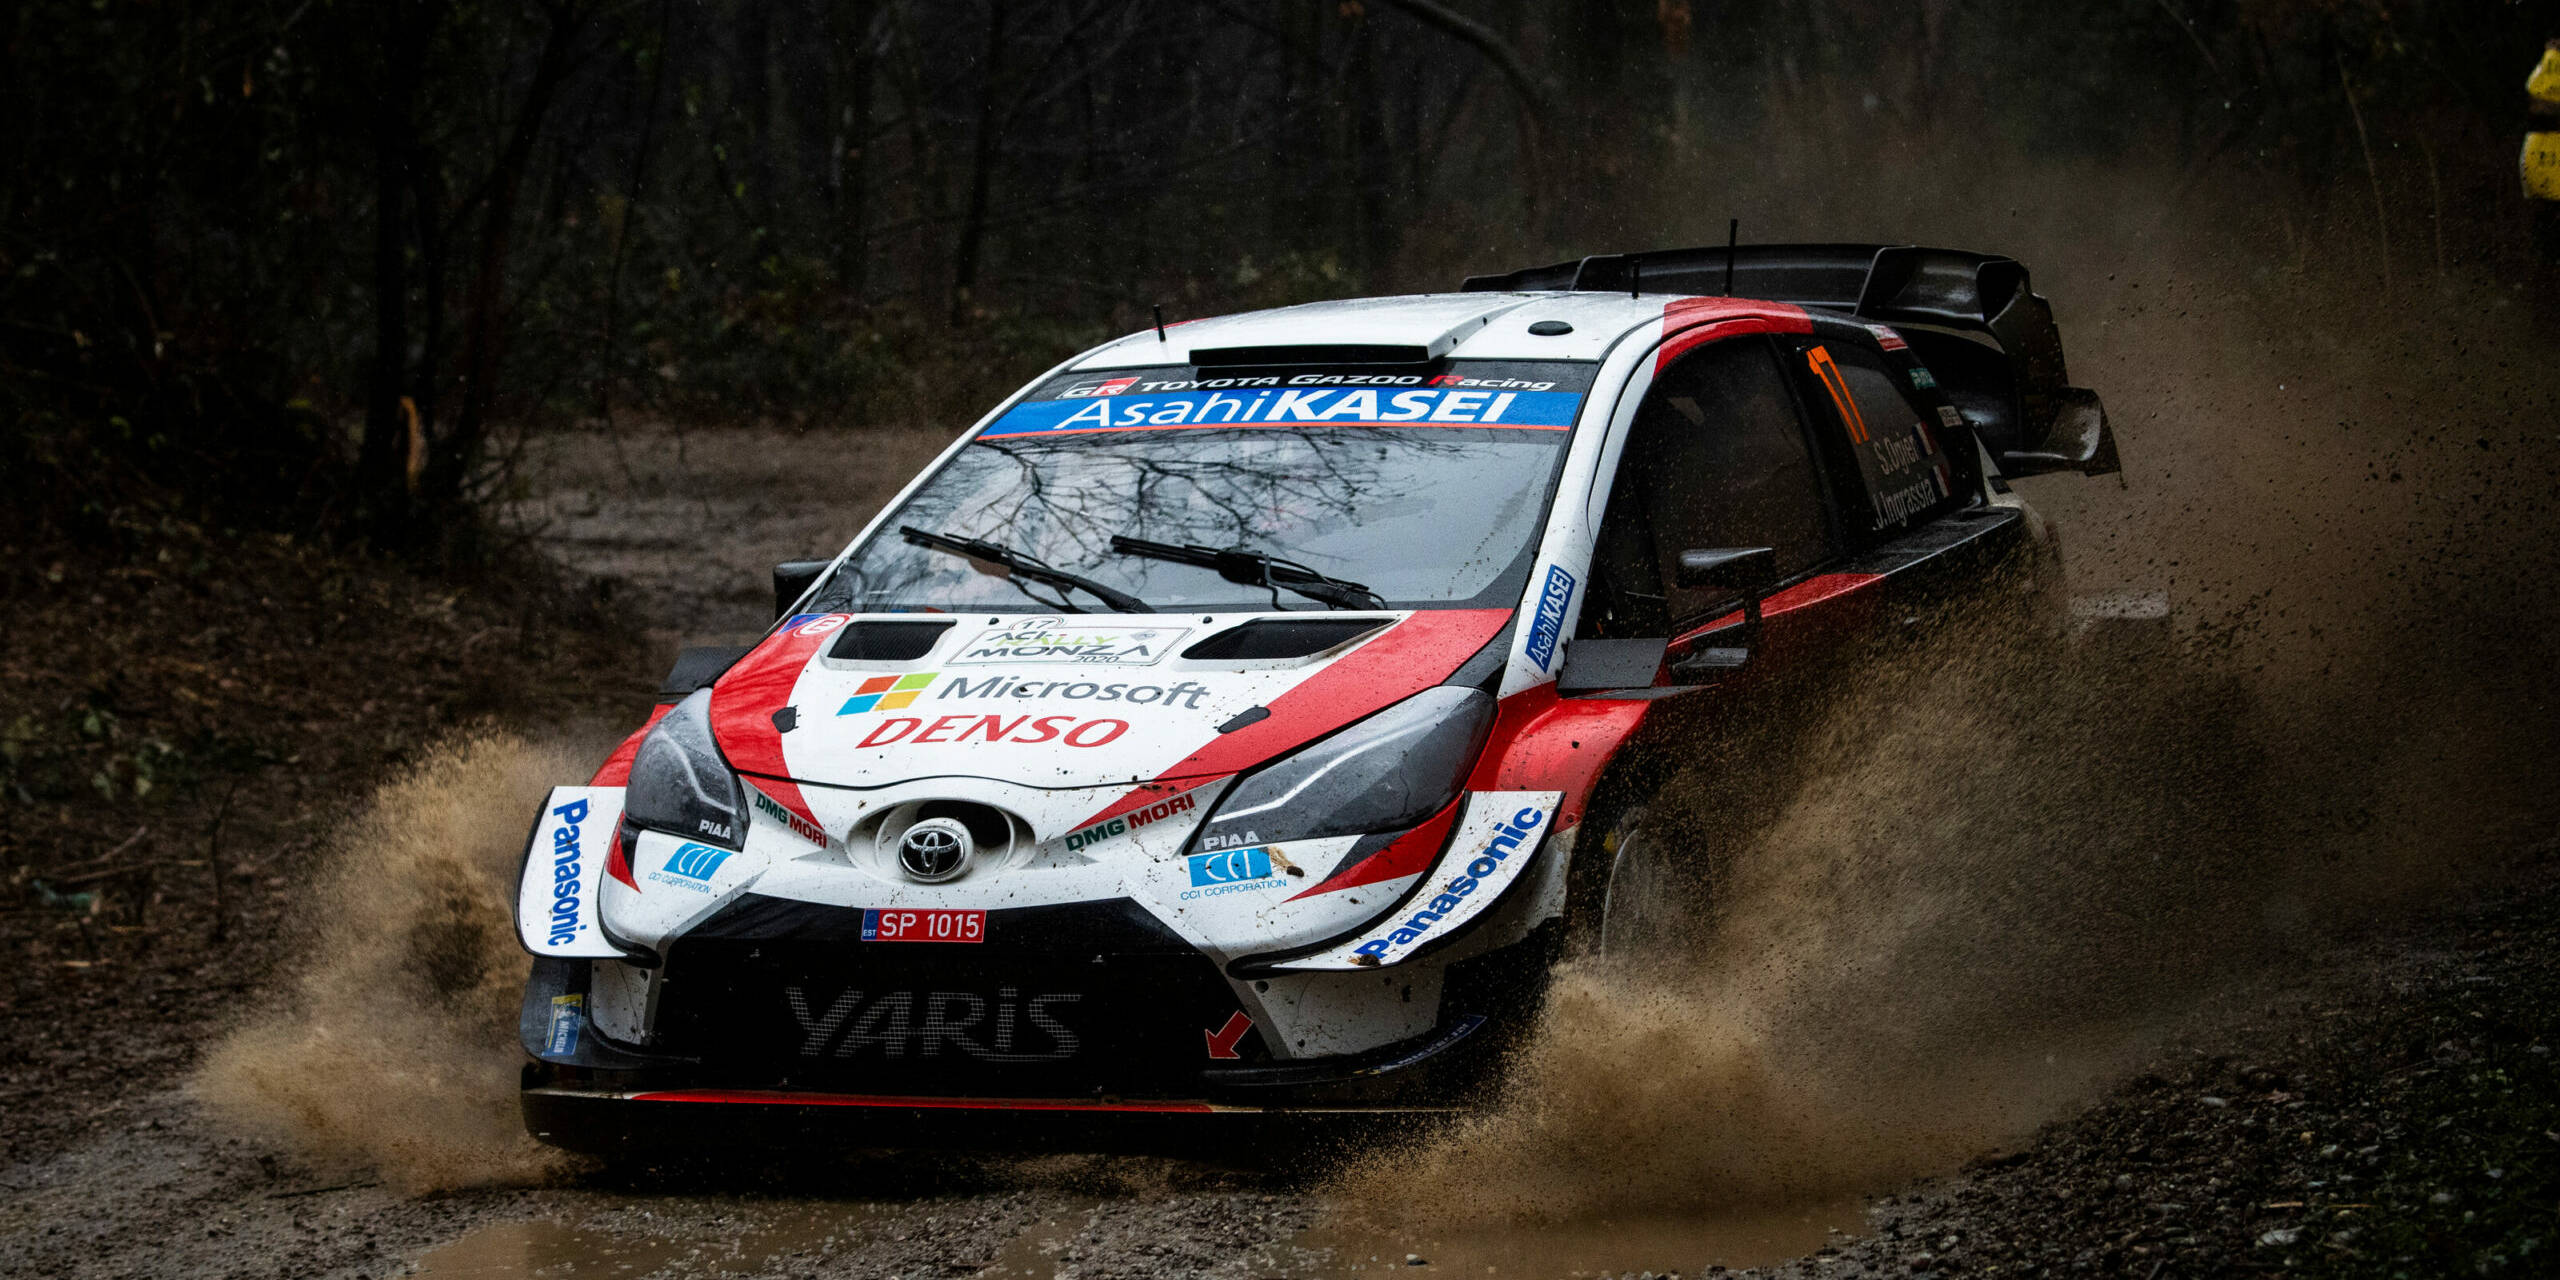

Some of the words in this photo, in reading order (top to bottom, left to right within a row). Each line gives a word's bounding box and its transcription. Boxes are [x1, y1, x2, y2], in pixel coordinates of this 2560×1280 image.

[1063, 386, 1125, 397] GR
[1140, 376, 1281, 392] TOYOTA
[1287, 374, 1423, 386] GAZOO
[1428, 375, 1556, 392] Racing
[1806, 345, 1869, 444] 17
[1053, 390, 1518, 430] AsahiKASEI
[1023, 620, 1057, 630] 17
[966, 644, 1150, 658] MONZA
[1070, 655, 1121, 663] 2020
[937, 676, 1210, 710] Microsoft
[854, 715, 1130, 749] DENSO
[698, 819, 731, 839] PIAA
[755, 792, 788, 824] DMG
[789, 814, 827, 848] MORI
[1065, 819, 1125, 851] DMG
[1127, 793, 1195, 829] MORI
[1203, 831, 1261, 850] PIAA
[547, 798, 589, 946] Panasonic
[1353, 807, 1542, 959] Panasonic
[1180, 891, 1201, 900] CCI
[1204, 879, 1287, 897] CORPORATION
[863, 929, 876, 937] EST
[881, 913, 917, 937] SP
[927, 914, 980, 938] 1015
